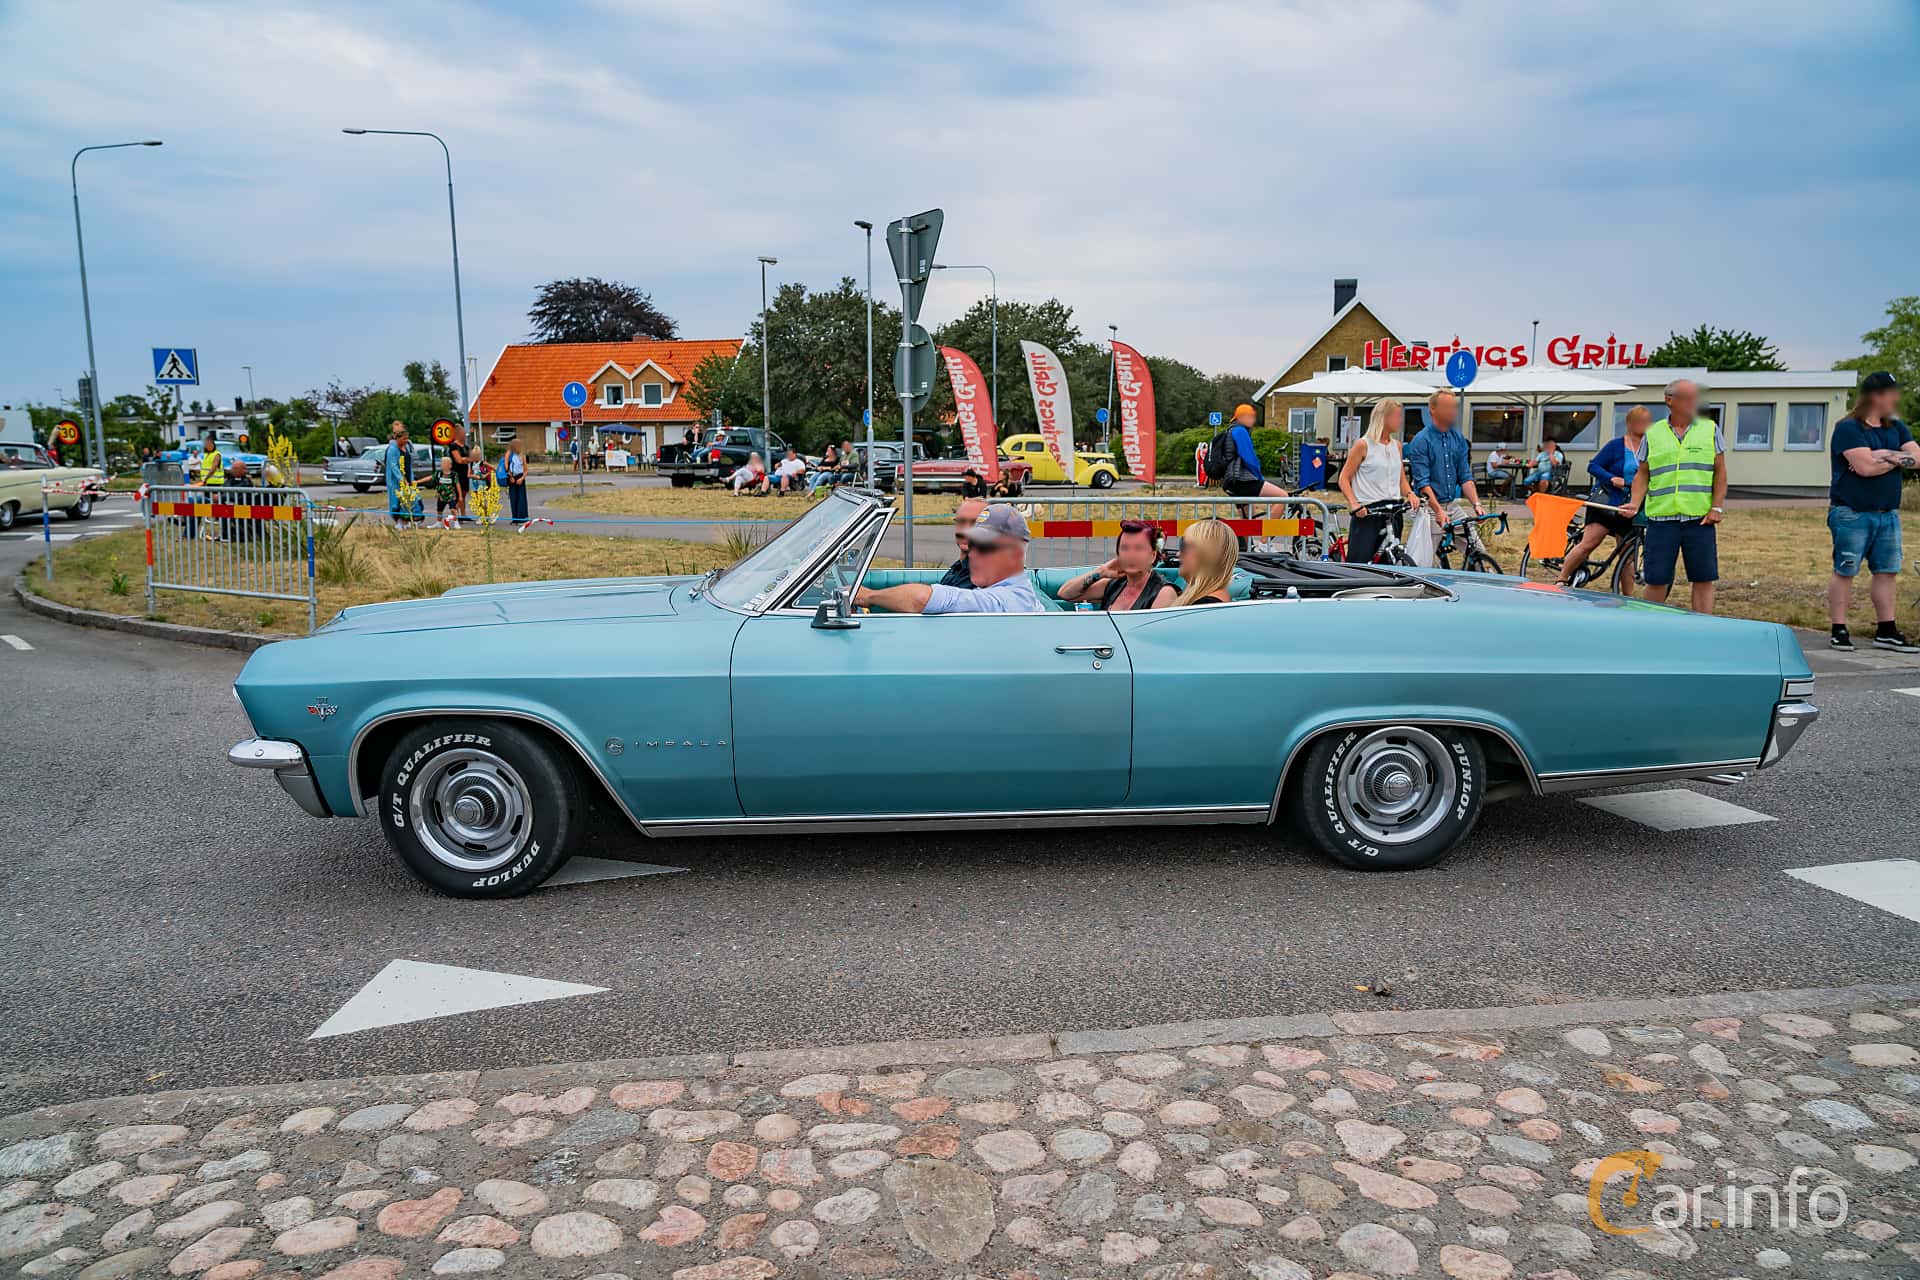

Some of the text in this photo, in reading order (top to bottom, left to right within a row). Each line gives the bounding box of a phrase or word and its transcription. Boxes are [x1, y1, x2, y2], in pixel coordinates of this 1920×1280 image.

[1547, 334, 1648, 369] GRILL
[62, 427, 75, 438] 30
[393, 734, 491, 828] G/T QUALIFIER
[1324, 731, 1379, 857] G/T QUALIFIER
[1452, 743, 1472, 821] DUNLOP
[472, 840, 541, 887] DUNLOP
